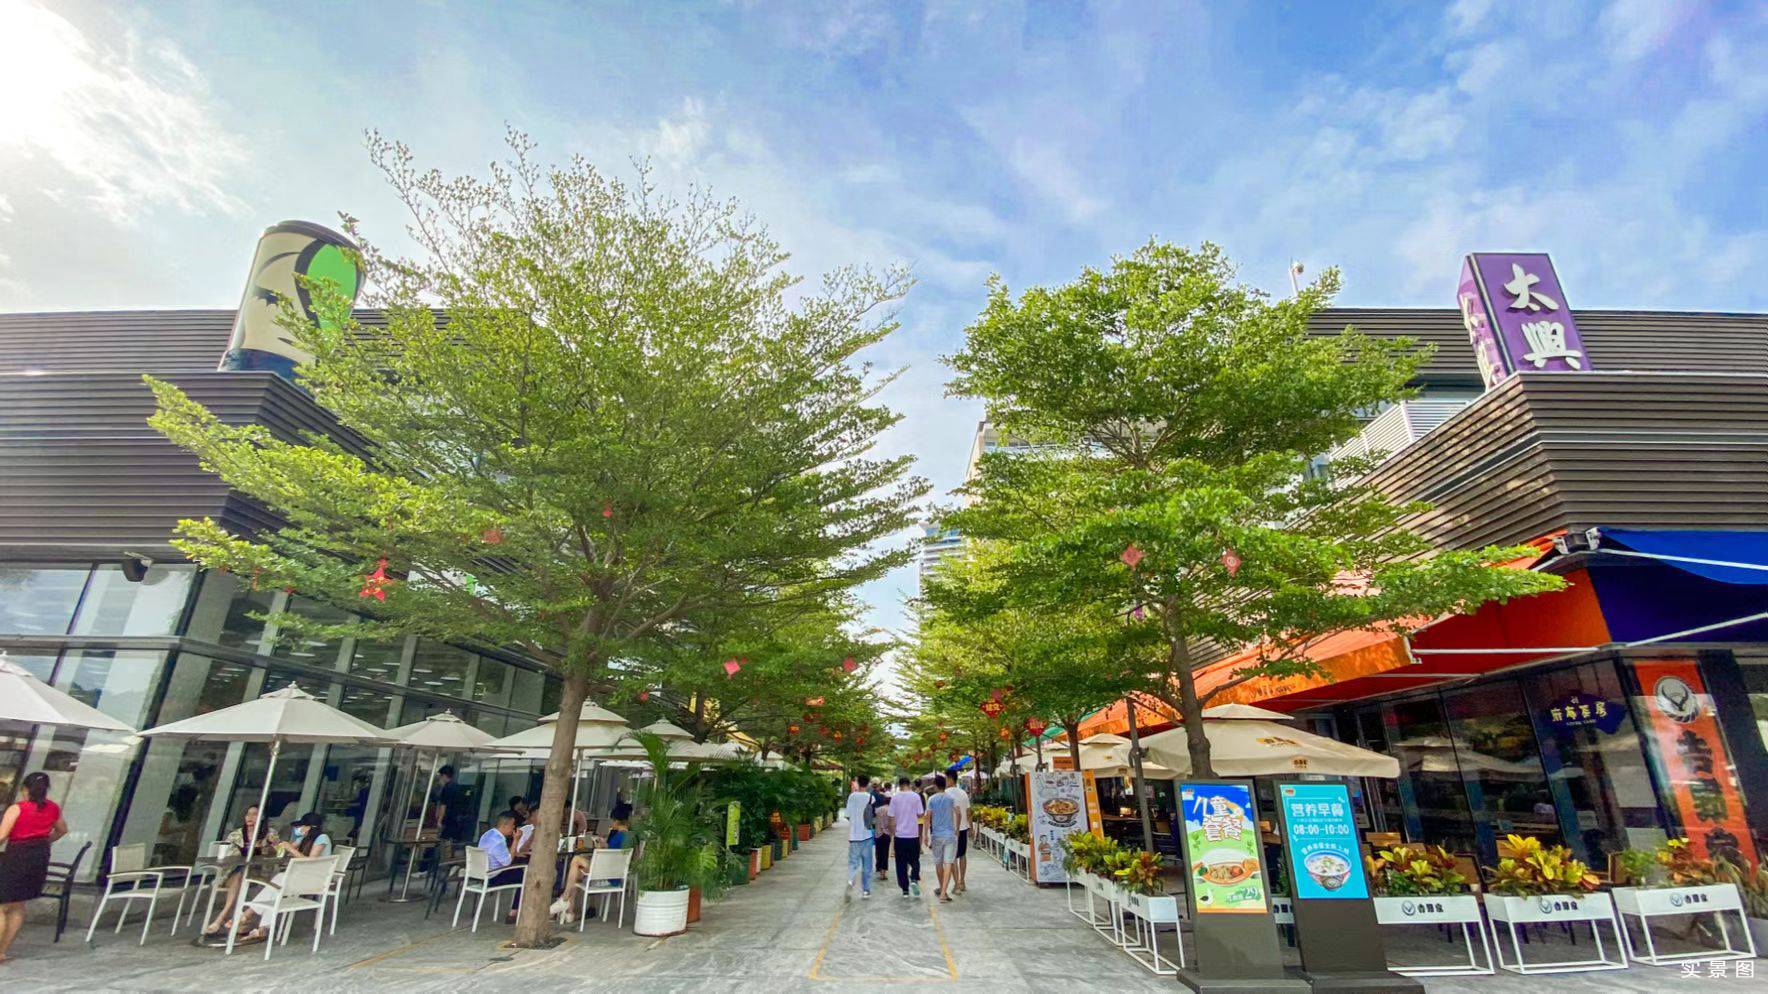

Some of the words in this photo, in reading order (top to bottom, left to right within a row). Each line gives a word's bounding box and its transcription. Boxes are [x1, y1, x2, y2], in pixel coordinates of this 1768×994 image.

[1192, 795, 1231, 817] 儿童
[1290, 802, 1345, 818] 营养早餐
[1202, 816, 1243, 842] 套餐
[1293, 824, 1350, 835] 08:00-10:00
